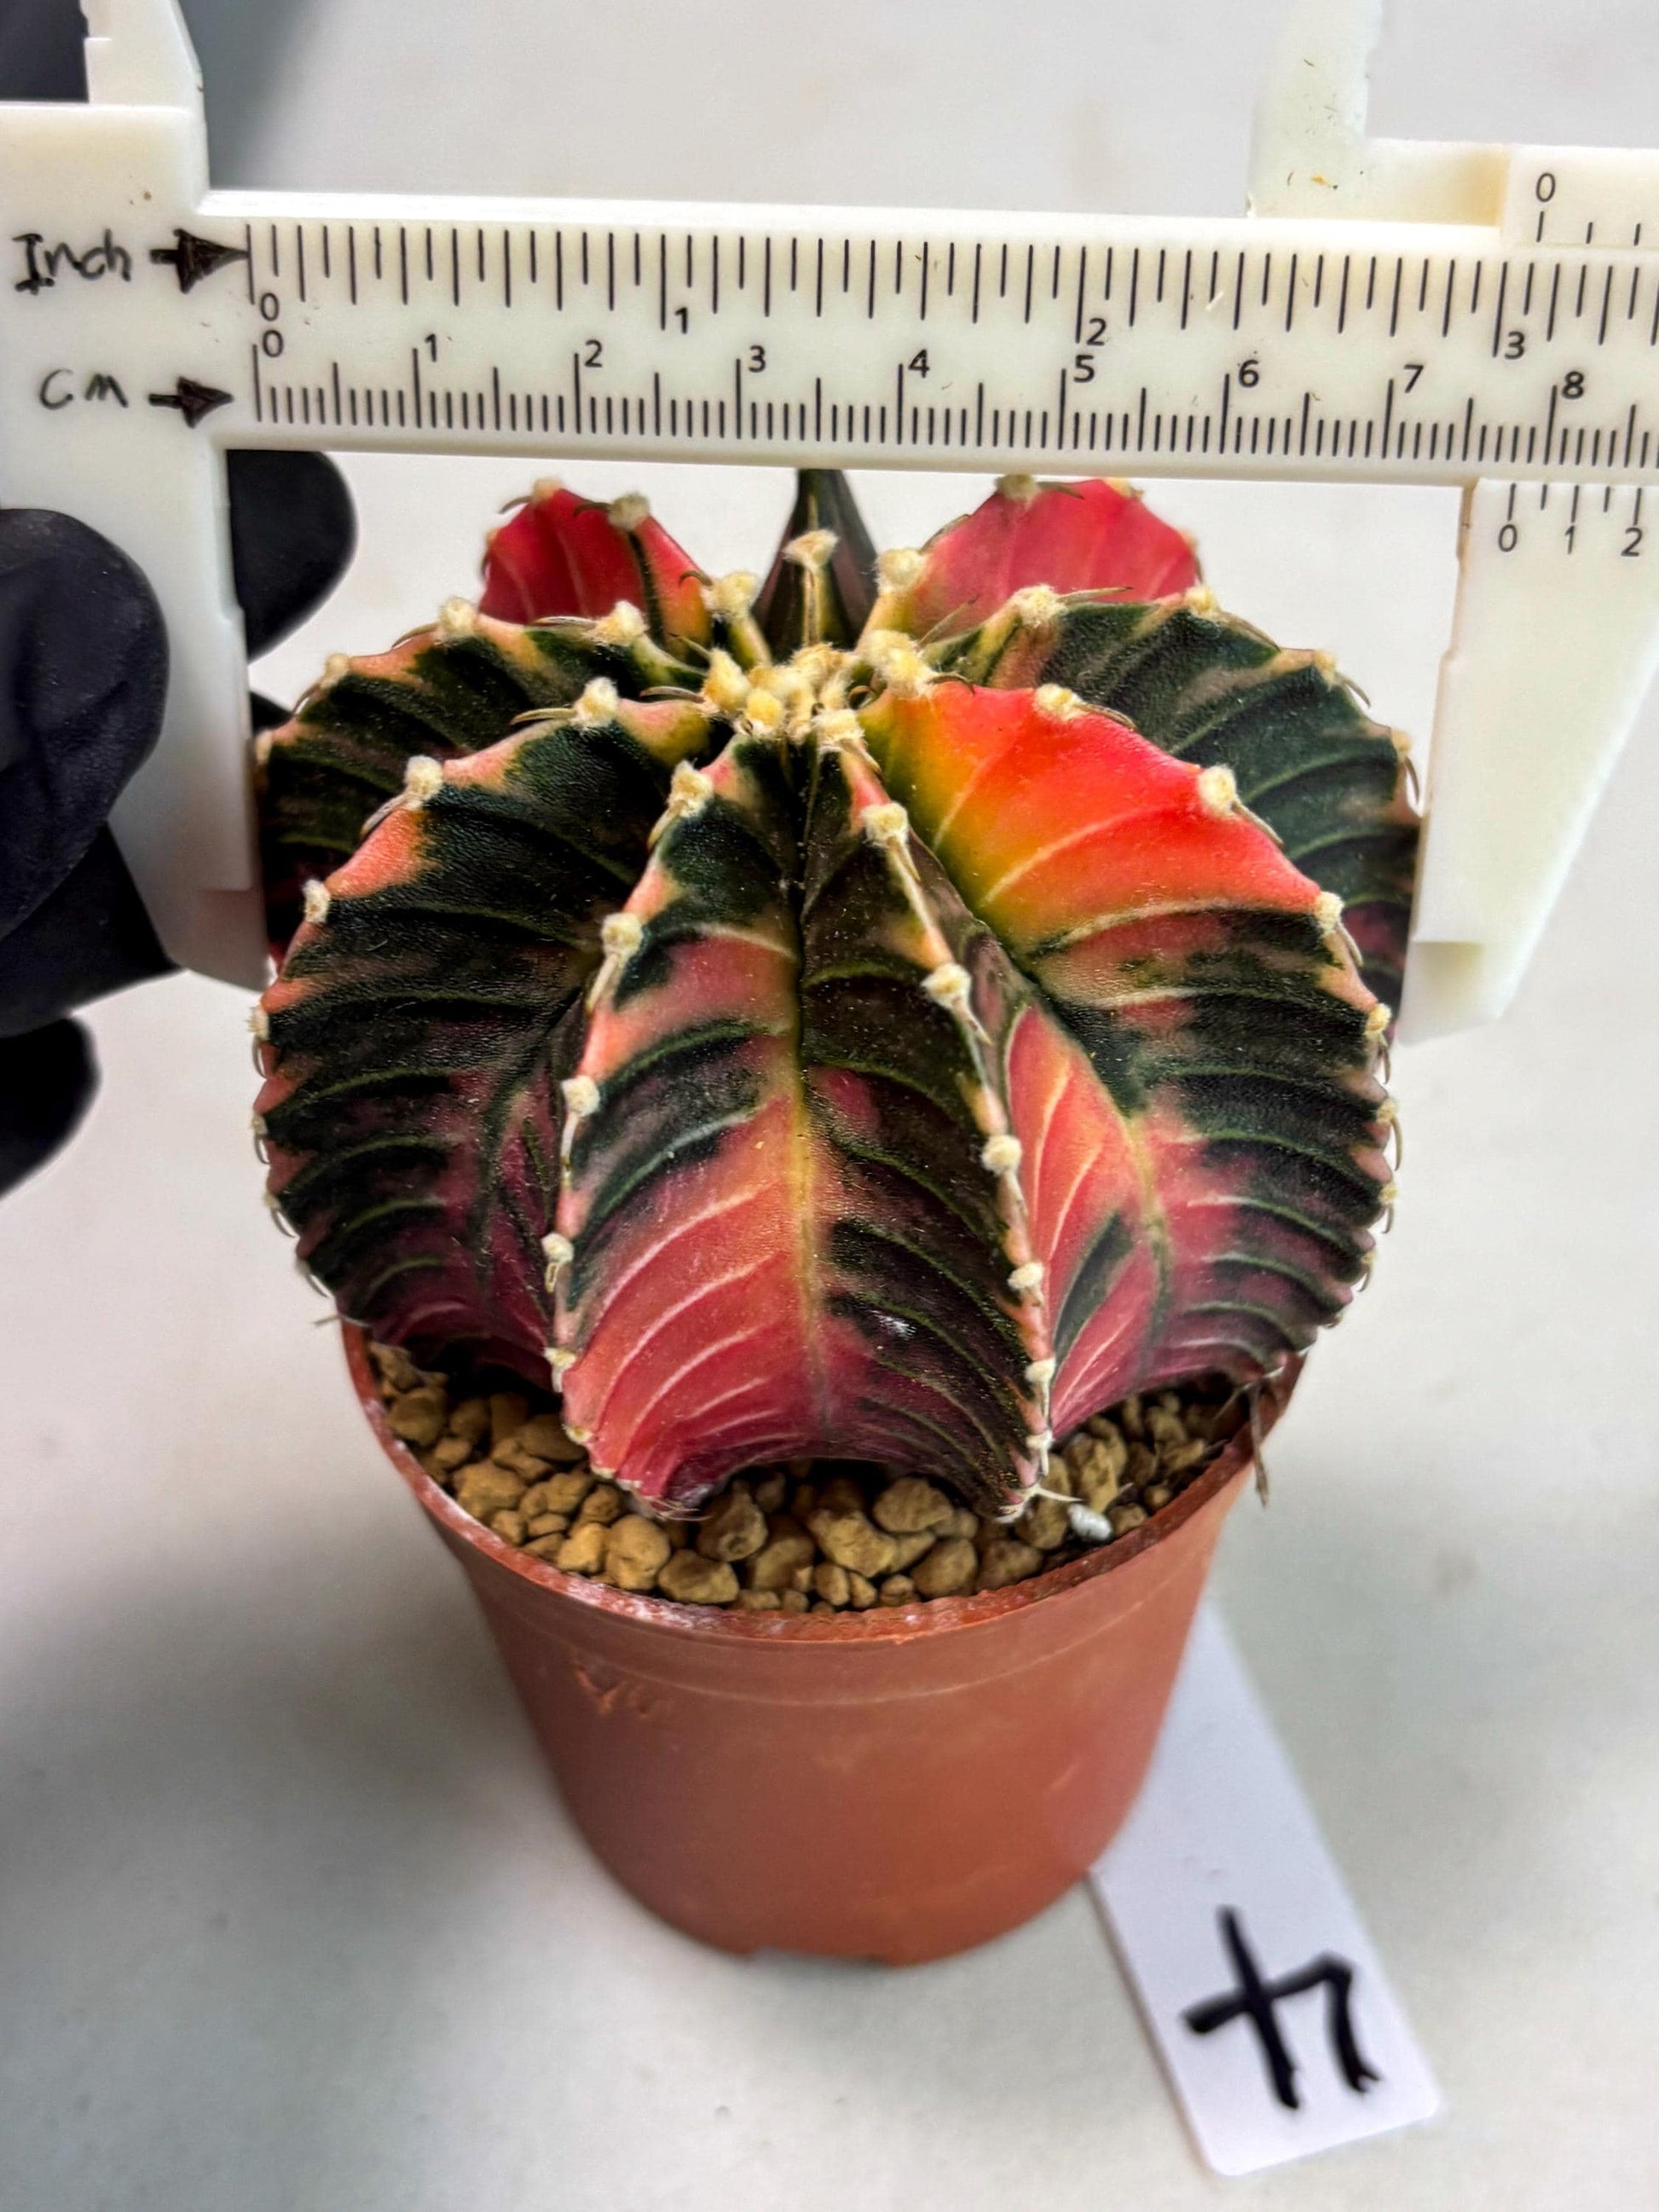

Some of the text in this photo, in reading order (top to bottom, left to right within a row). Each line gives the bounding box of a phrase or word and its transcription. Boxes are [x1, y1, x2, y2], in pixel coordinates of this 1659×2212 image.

[1535, 171, 1557, 204] 0
[11, 228, 131, 296] Inch
[258, 292, 1526, 361] 0 1 2 3
[261, 328, 1586, 400] 0 1 2 3 4 5 6 7 8
[1497, 523, 1644, 557] 0 1 2
